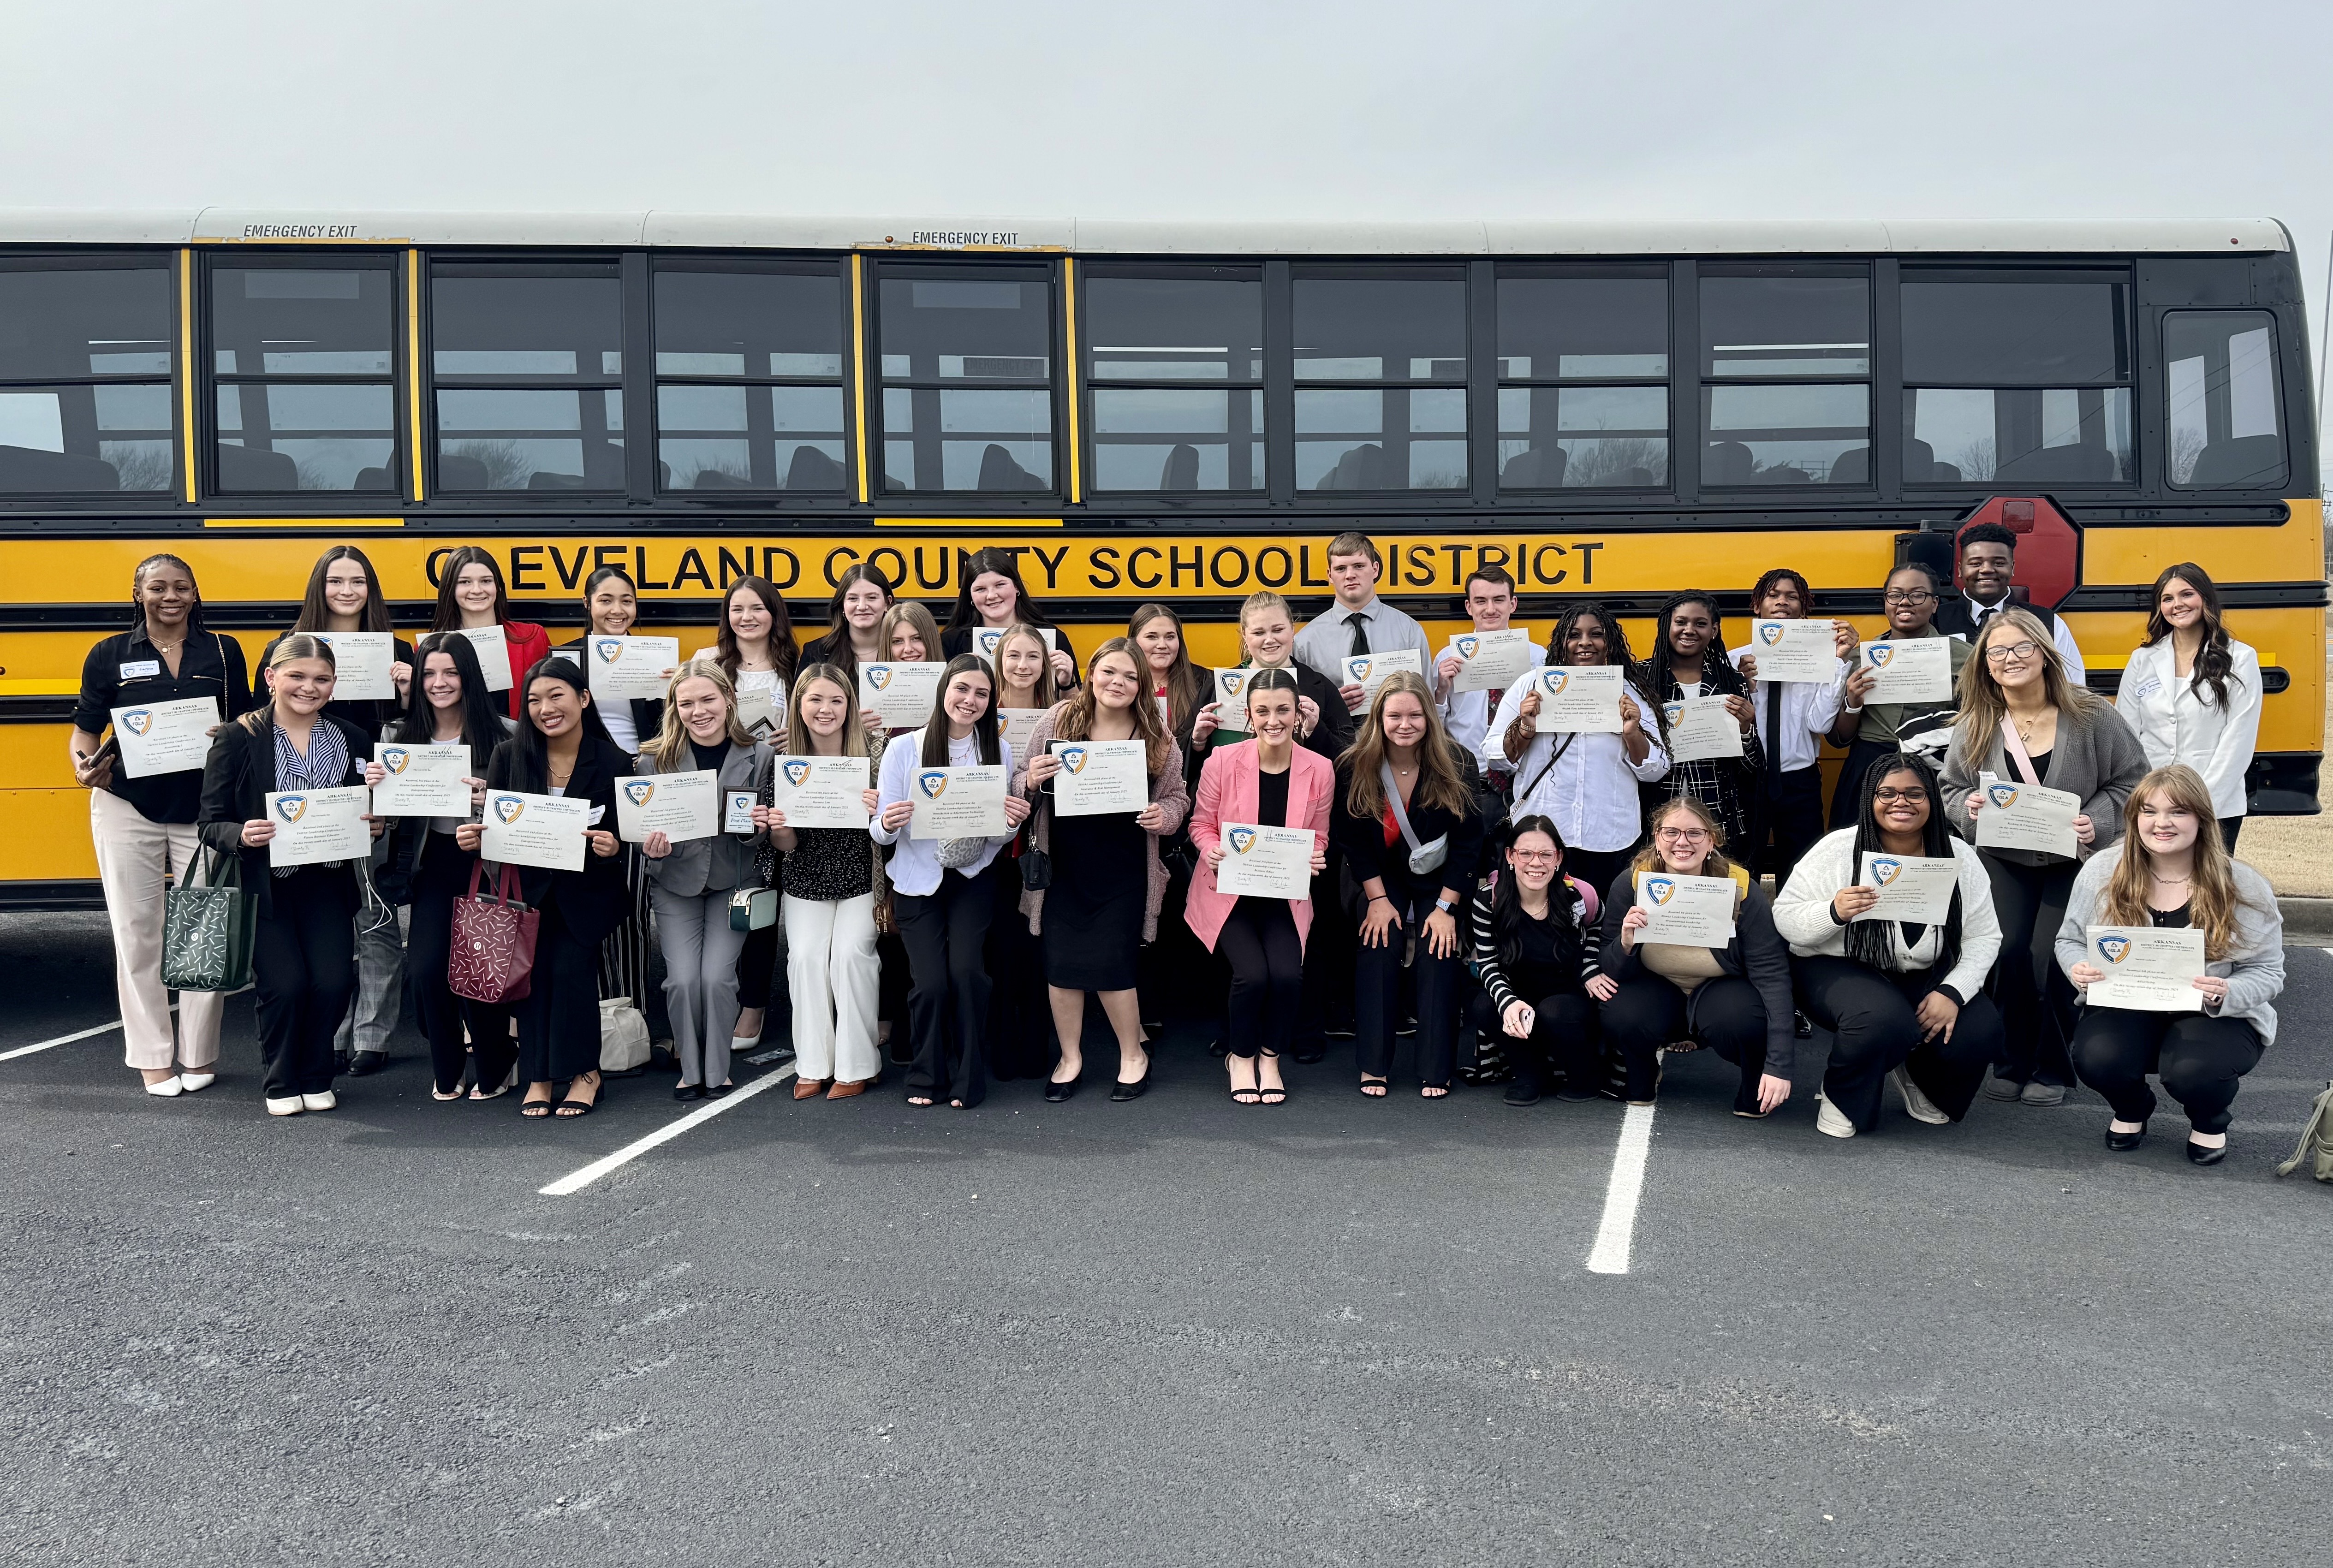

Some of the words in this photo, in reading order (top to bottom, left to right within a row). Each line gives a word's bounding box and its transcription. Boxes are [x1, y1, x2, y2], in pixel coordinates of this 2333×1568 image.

[244, 225, 325, 237] EMERGENCY
[328, 226, 357, 237] EXIT
[913, 232, 988, 244] EMERGENCY
[993, 233, 1018, 244] EXIT
[426, 546, 800, 590] CEVELAND
[1089, 546, 1329, 587] SCHOOL
[1373, 543, 1604, 587] ISTRICT
